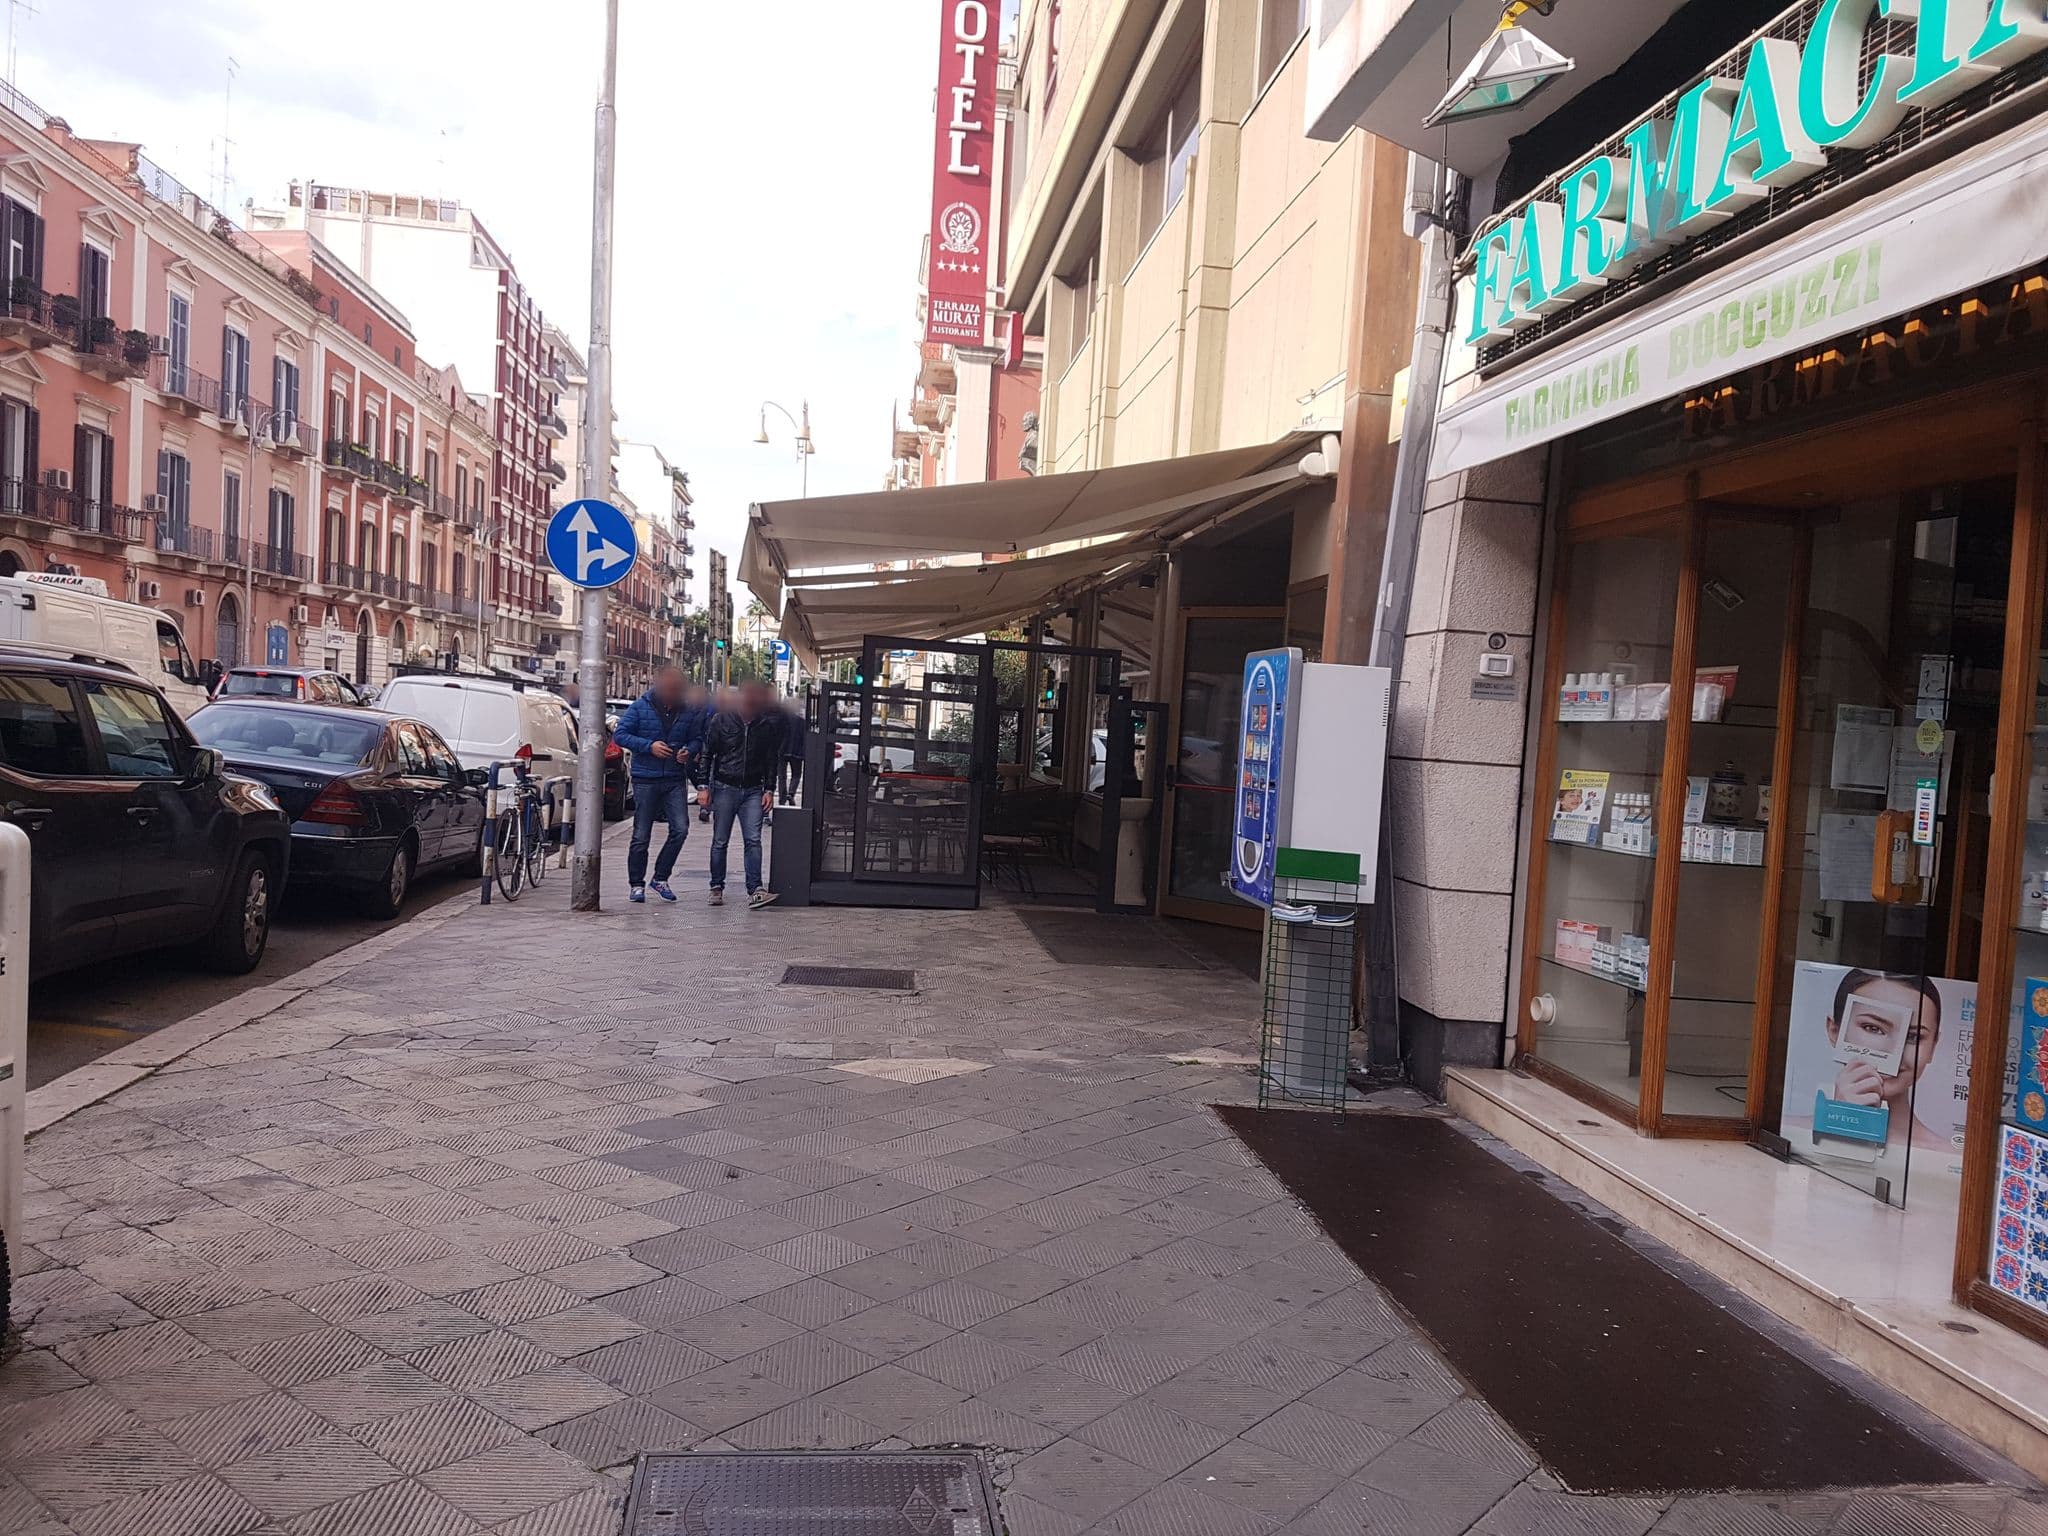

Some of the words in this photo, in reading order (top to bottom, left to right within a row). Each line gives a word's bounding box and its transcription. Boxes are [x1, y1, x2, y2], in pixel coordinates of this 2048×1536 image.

[933, 300, 980, 313] TERRAZZA
[932, 309, 981, 326] MURAT
[932, 325, 980, 338] RISTORANTE
[1505, 344, 1641, 442] FARMACIA
[1667, 239, 1882, 381] BOCCUZZI
[36, 575, 83, 586] POLARCAR
